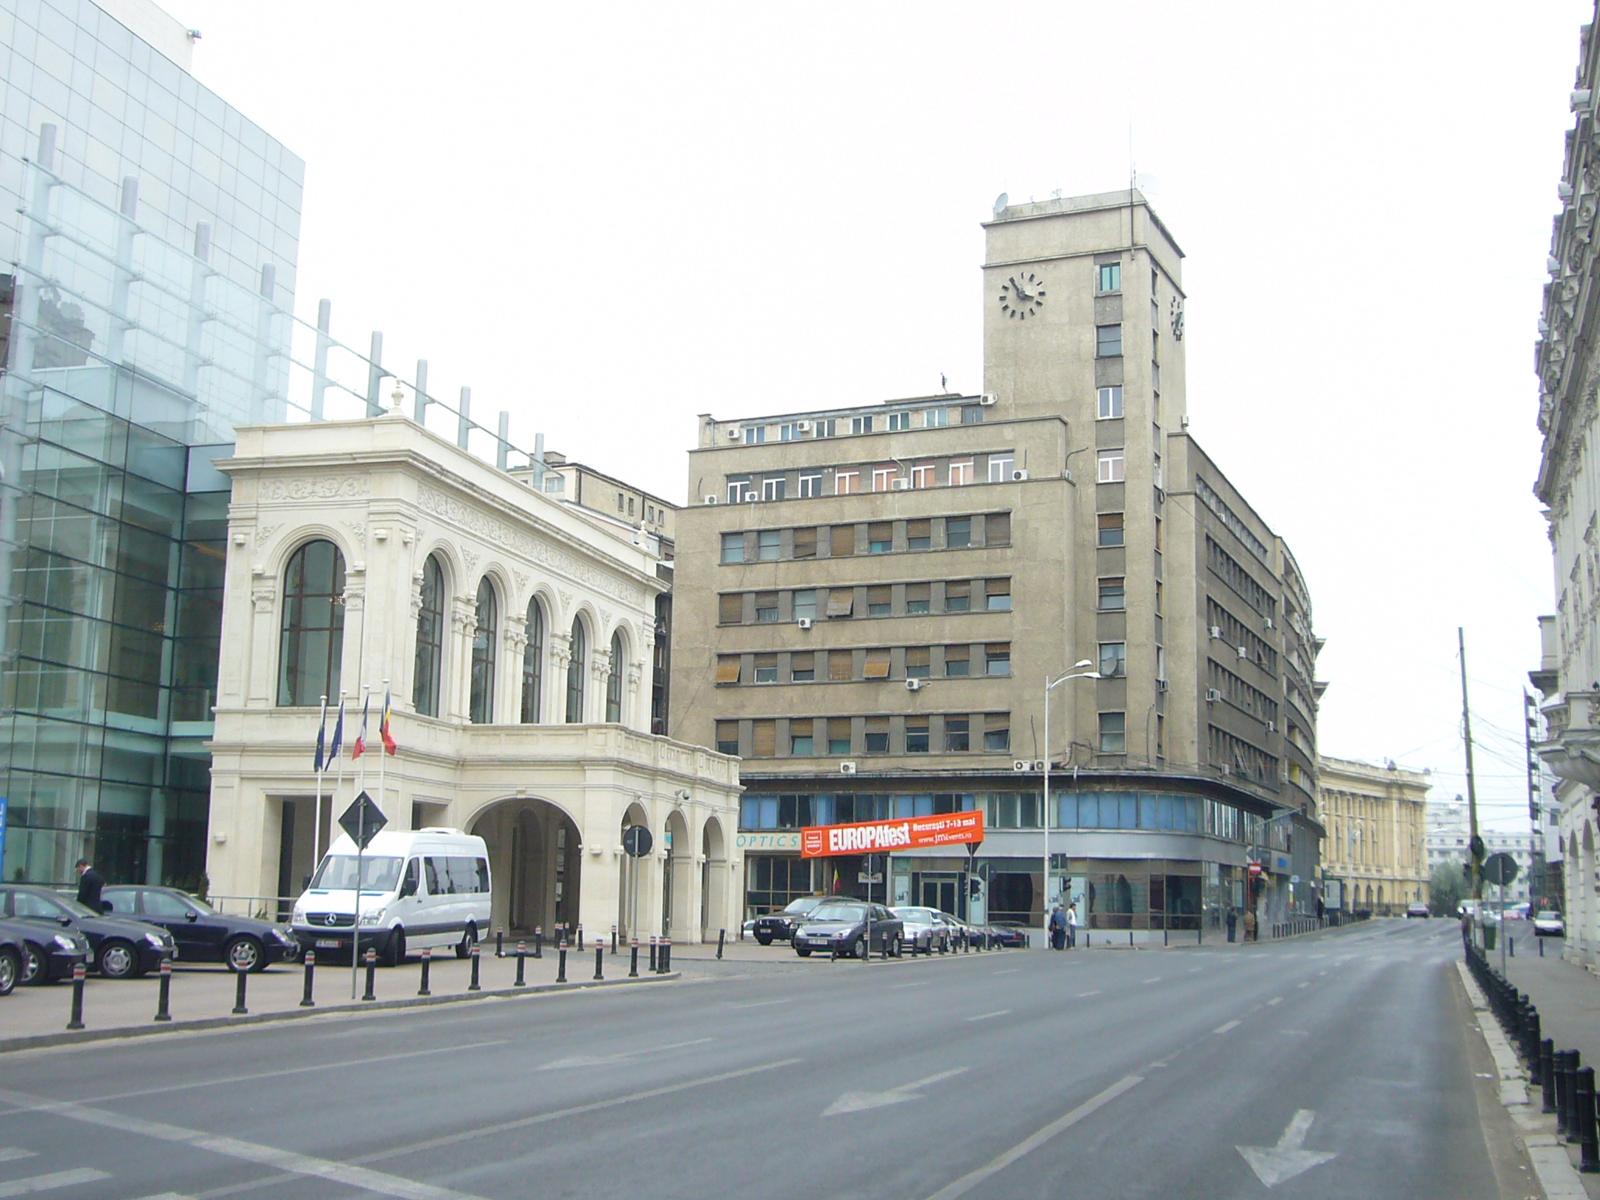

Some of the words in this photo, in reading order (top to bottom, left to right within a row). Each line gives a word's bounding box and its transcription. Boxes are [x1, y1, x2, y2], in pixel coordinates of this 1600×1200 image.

[962, 817, 976, 826] mai
[736, 835, 799, 847] OPTICS
[829, 822, 911, 851] EUROPAfest
